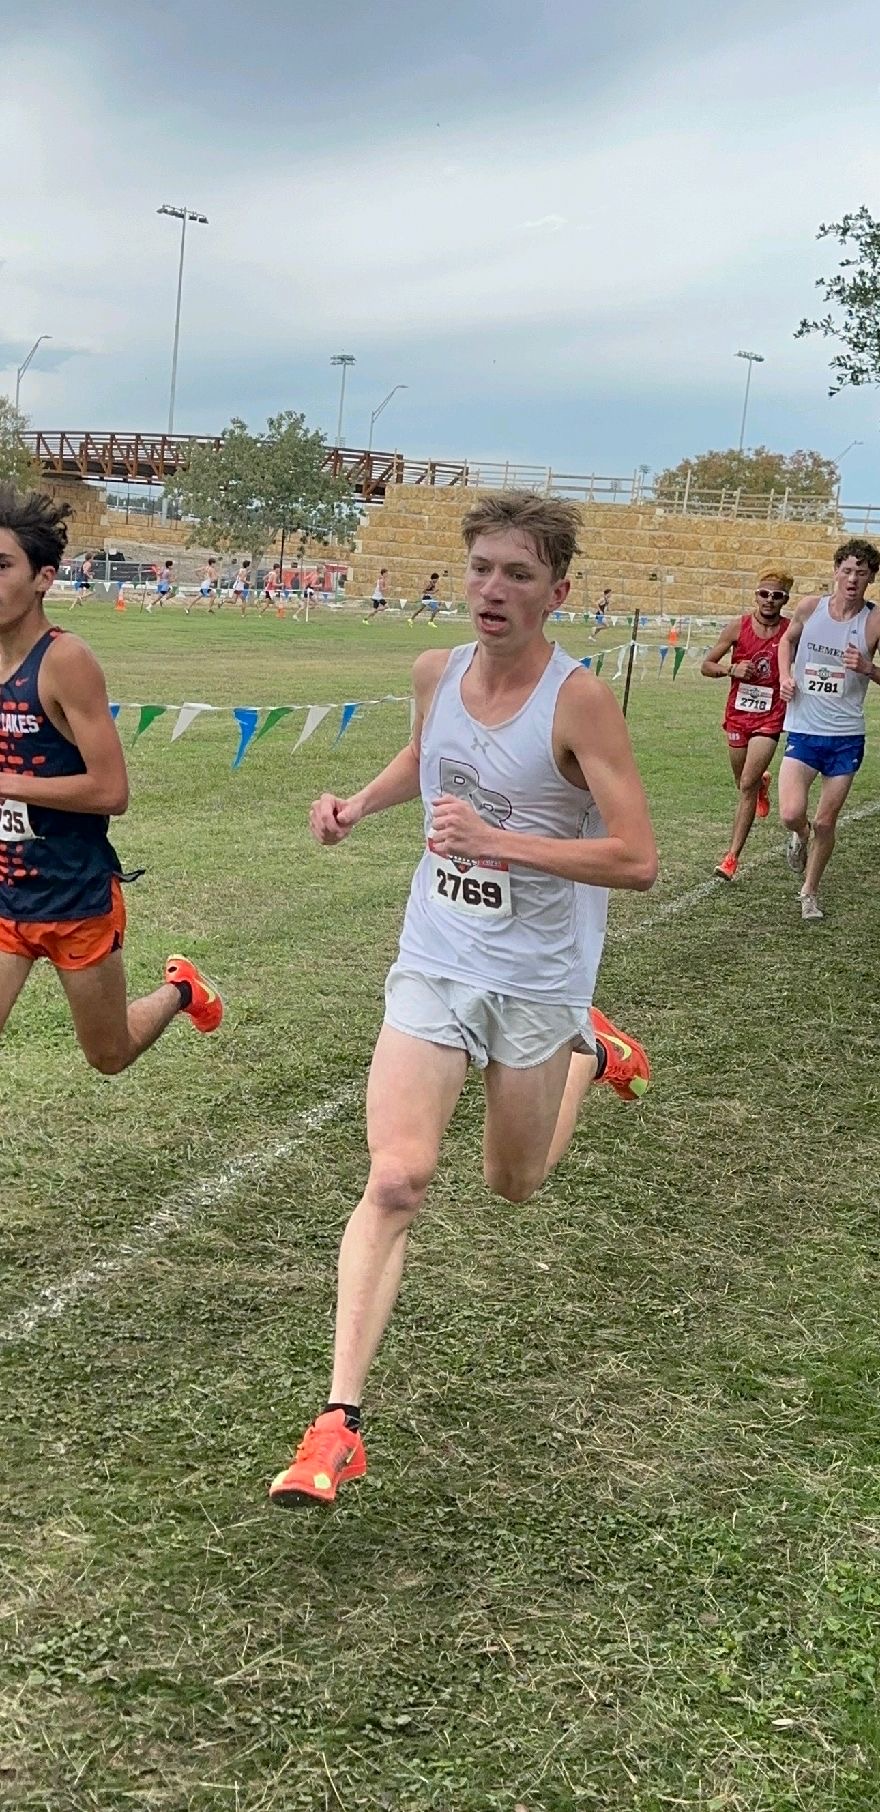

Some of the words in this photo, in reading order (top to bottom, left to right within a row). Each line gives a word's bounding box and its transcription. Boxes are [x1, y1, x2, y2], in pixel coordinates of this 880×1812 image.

[808, 680, 838, 693] 2781
[1, 713, 40, 733] LAKES
[0, 808, 25, 834] 35
[436, 867, 502, 909] 2769
